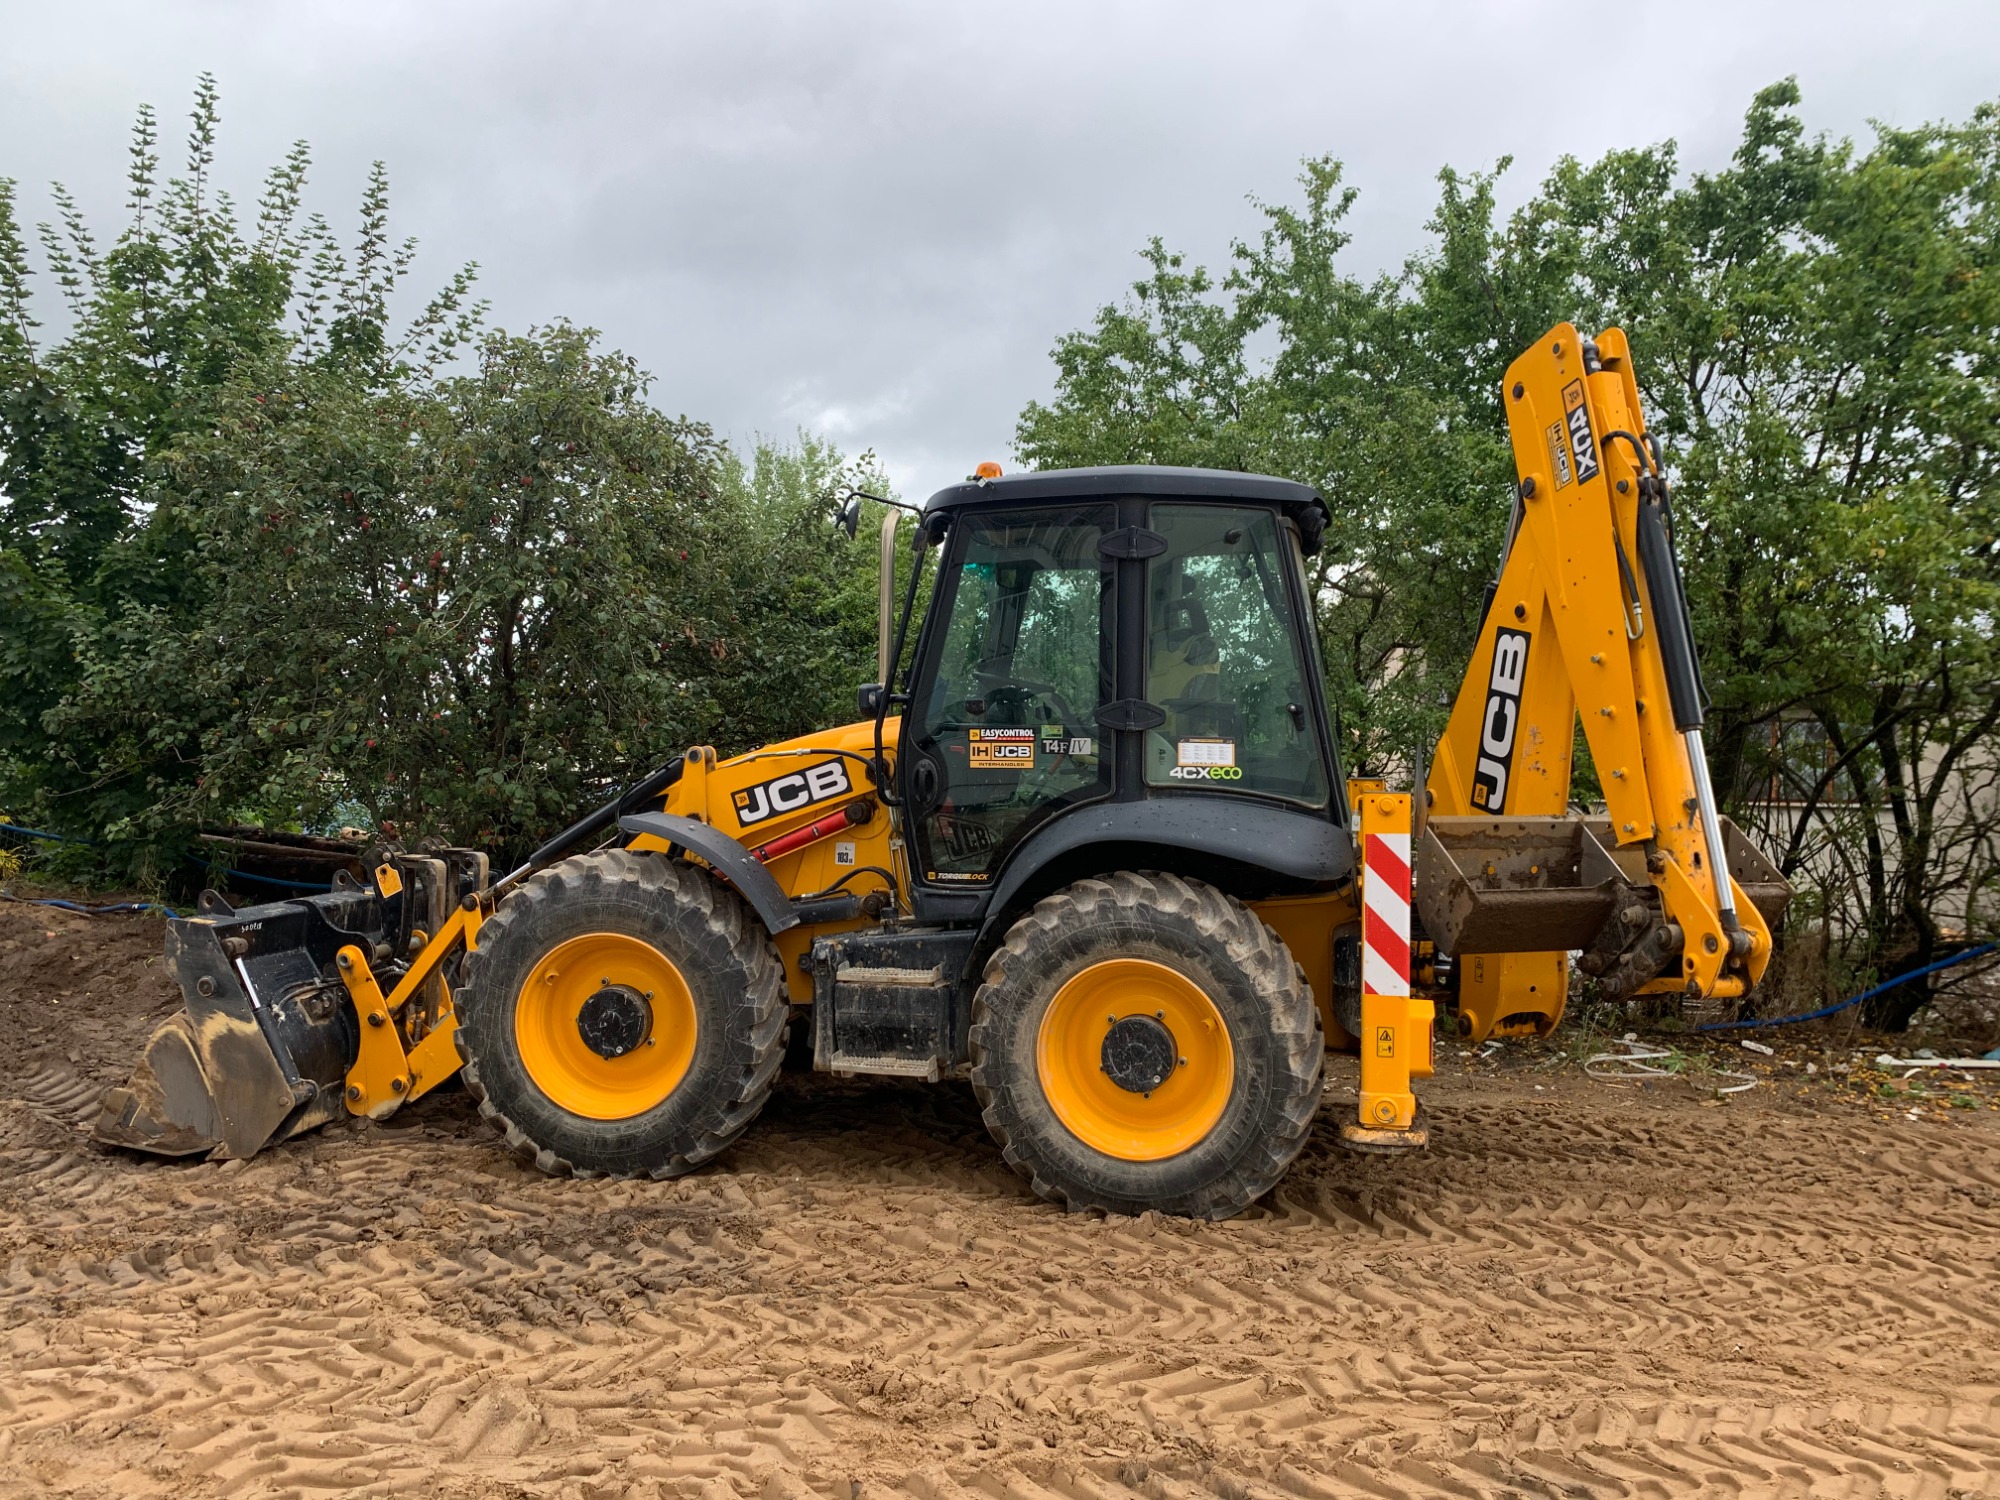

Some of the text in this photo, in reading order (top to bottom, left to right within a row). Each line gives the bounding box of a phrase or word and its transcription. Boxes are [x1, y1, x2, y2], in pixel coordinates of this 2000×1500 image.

[1553, 423, 1562, 442] IH
[1569, 406, 1598, 477] 4CX
[1556, 447, 1571, 483] JCB
[980, 729, 1035, 739] EASYCONTROL
[1477, 633, 1527, 810] JCB
[972, 746, 1031, 757] IH JCB
[739, 761, 848, 823] JCB
[946, 819, 989, 857] JCB
[837, 852, 849, 863] 103
[937, 872, 989, 880] TORQUELOCK
